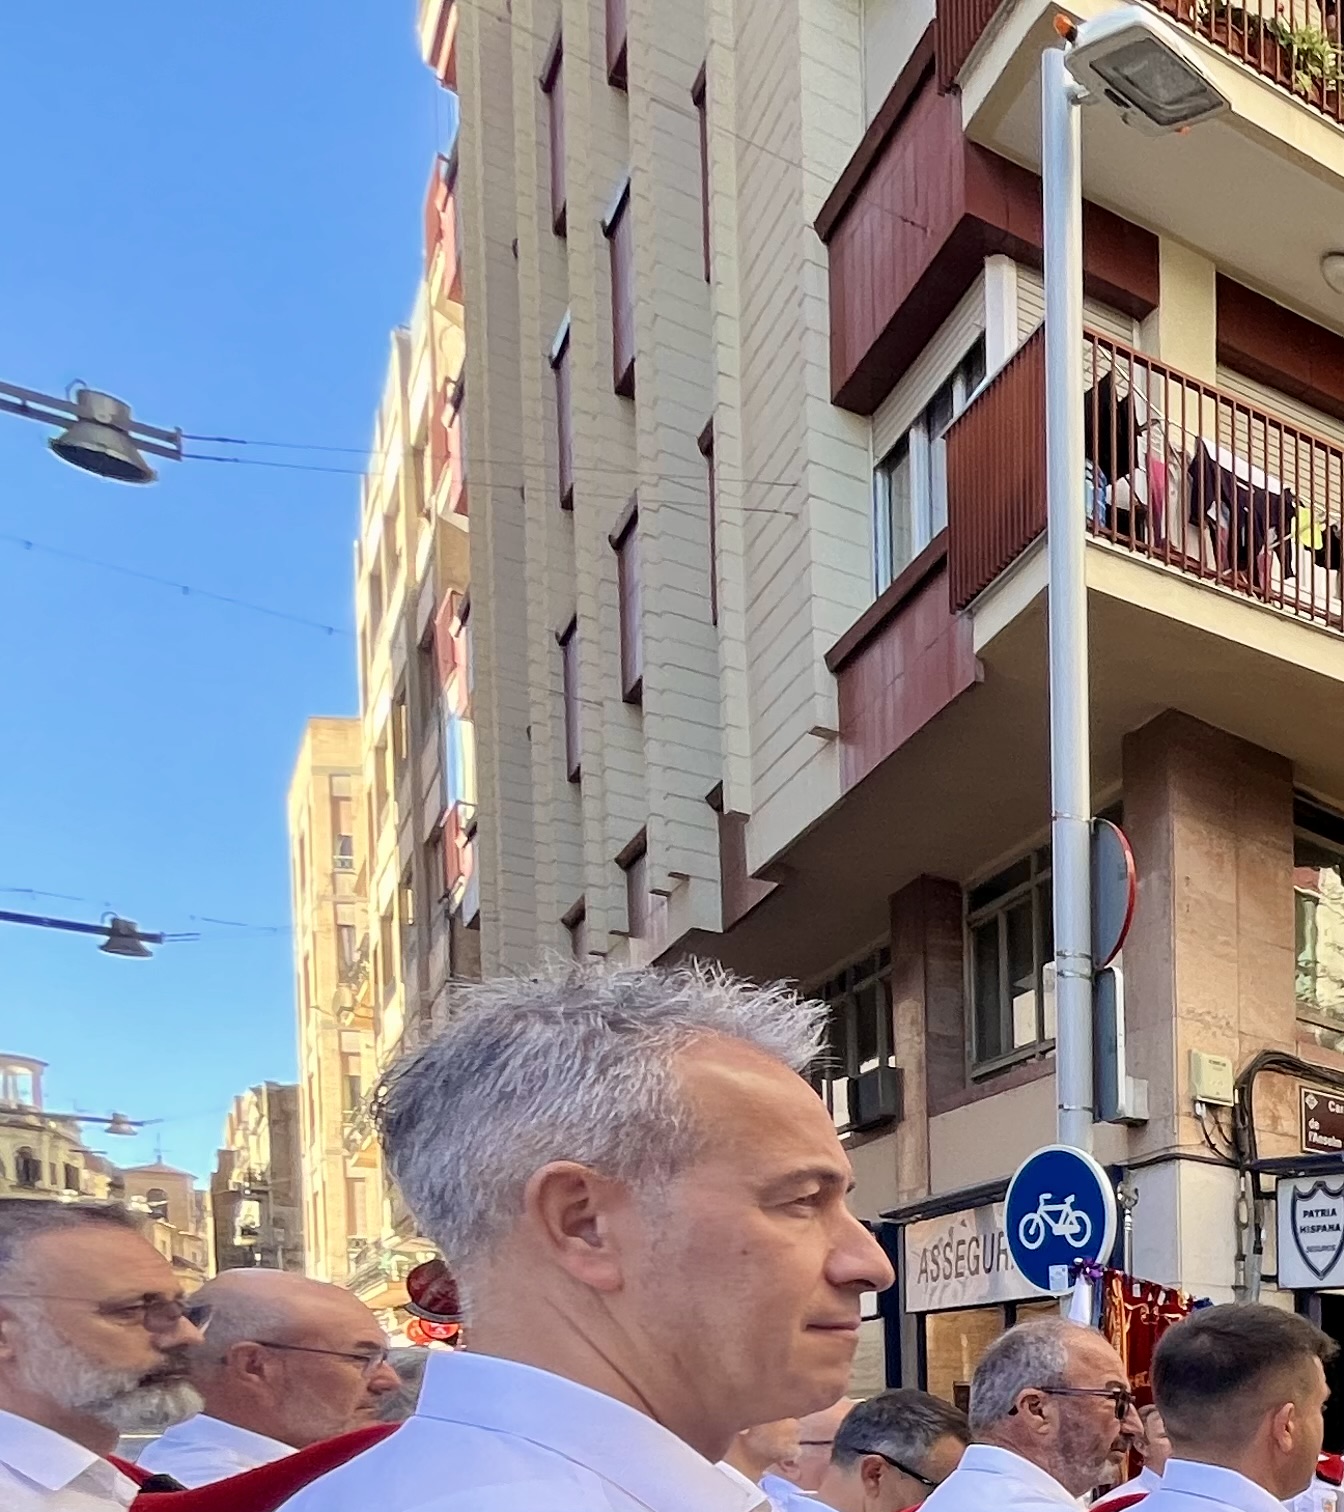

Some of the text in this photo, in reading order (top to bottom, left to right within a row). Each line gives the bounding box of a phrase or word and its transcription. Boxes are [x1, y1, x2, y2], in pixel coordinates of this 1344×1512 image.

[1302, 1208, 1337, 1218] PATRIA
[1299, 1223, 1341, 1234] HISPANA
[917, 1231, 1015, 1285] ASSEGUR
